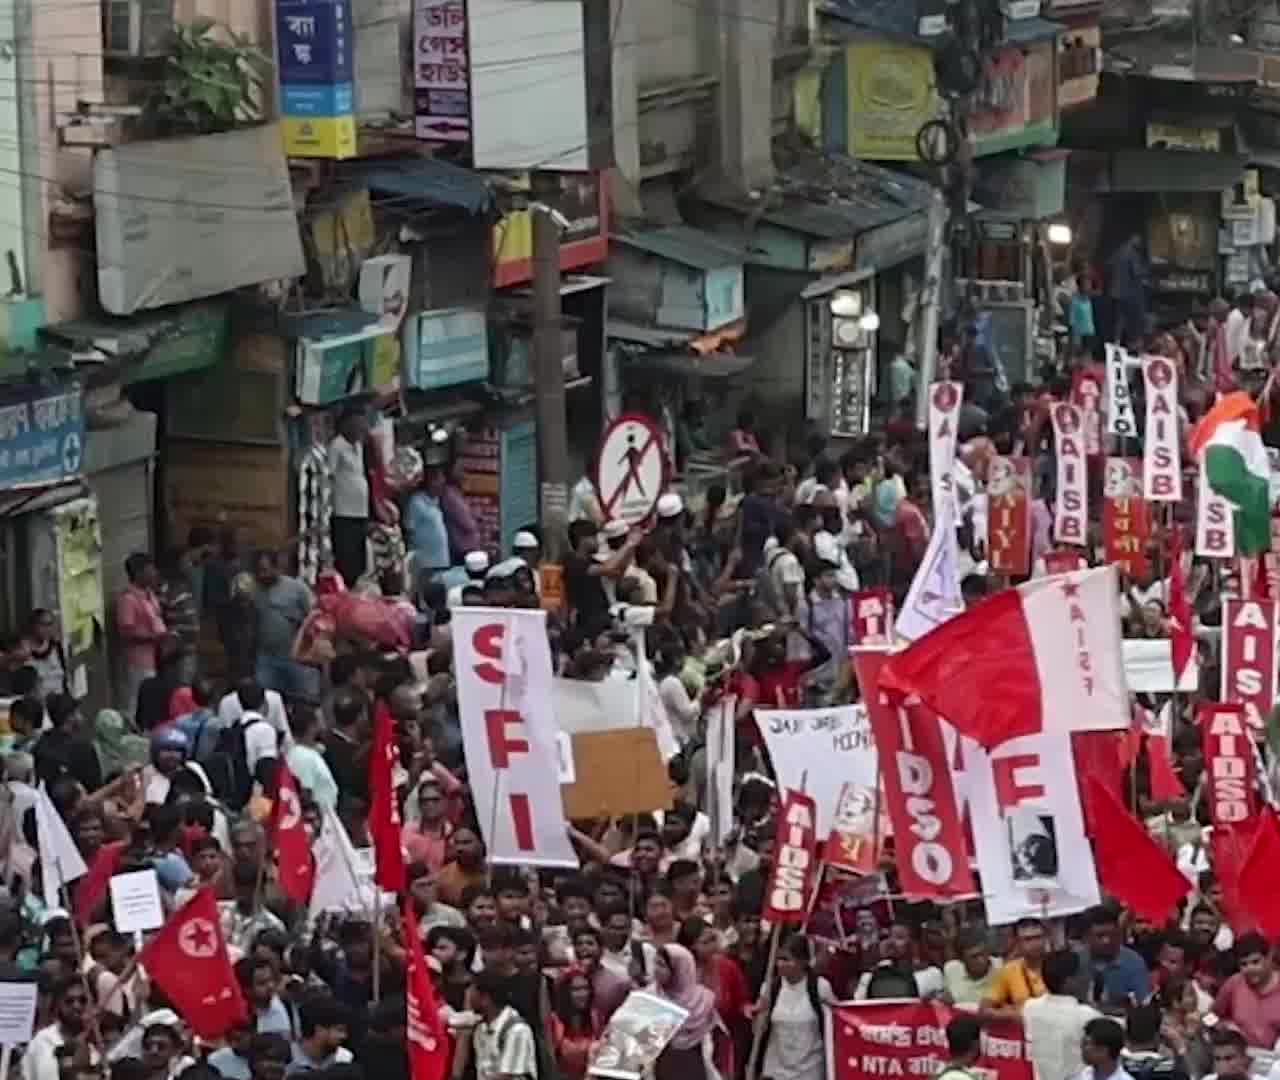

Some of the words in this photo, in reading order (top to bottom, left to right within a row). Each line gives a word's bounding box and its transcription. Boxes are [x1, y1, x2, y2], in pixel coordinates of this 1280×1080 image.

[1059, 437, 1082, 538] AISB
[1151, 395, 1174, 495] AISB
[473, 623, 536, 851] SFI
[878, 691, 954, 886] IDSO
[1210, 711, 1249, 822] AIDSO
[770, 803, 812, 911] AIDSO
[862, 1056, 904, 1076] NTA
